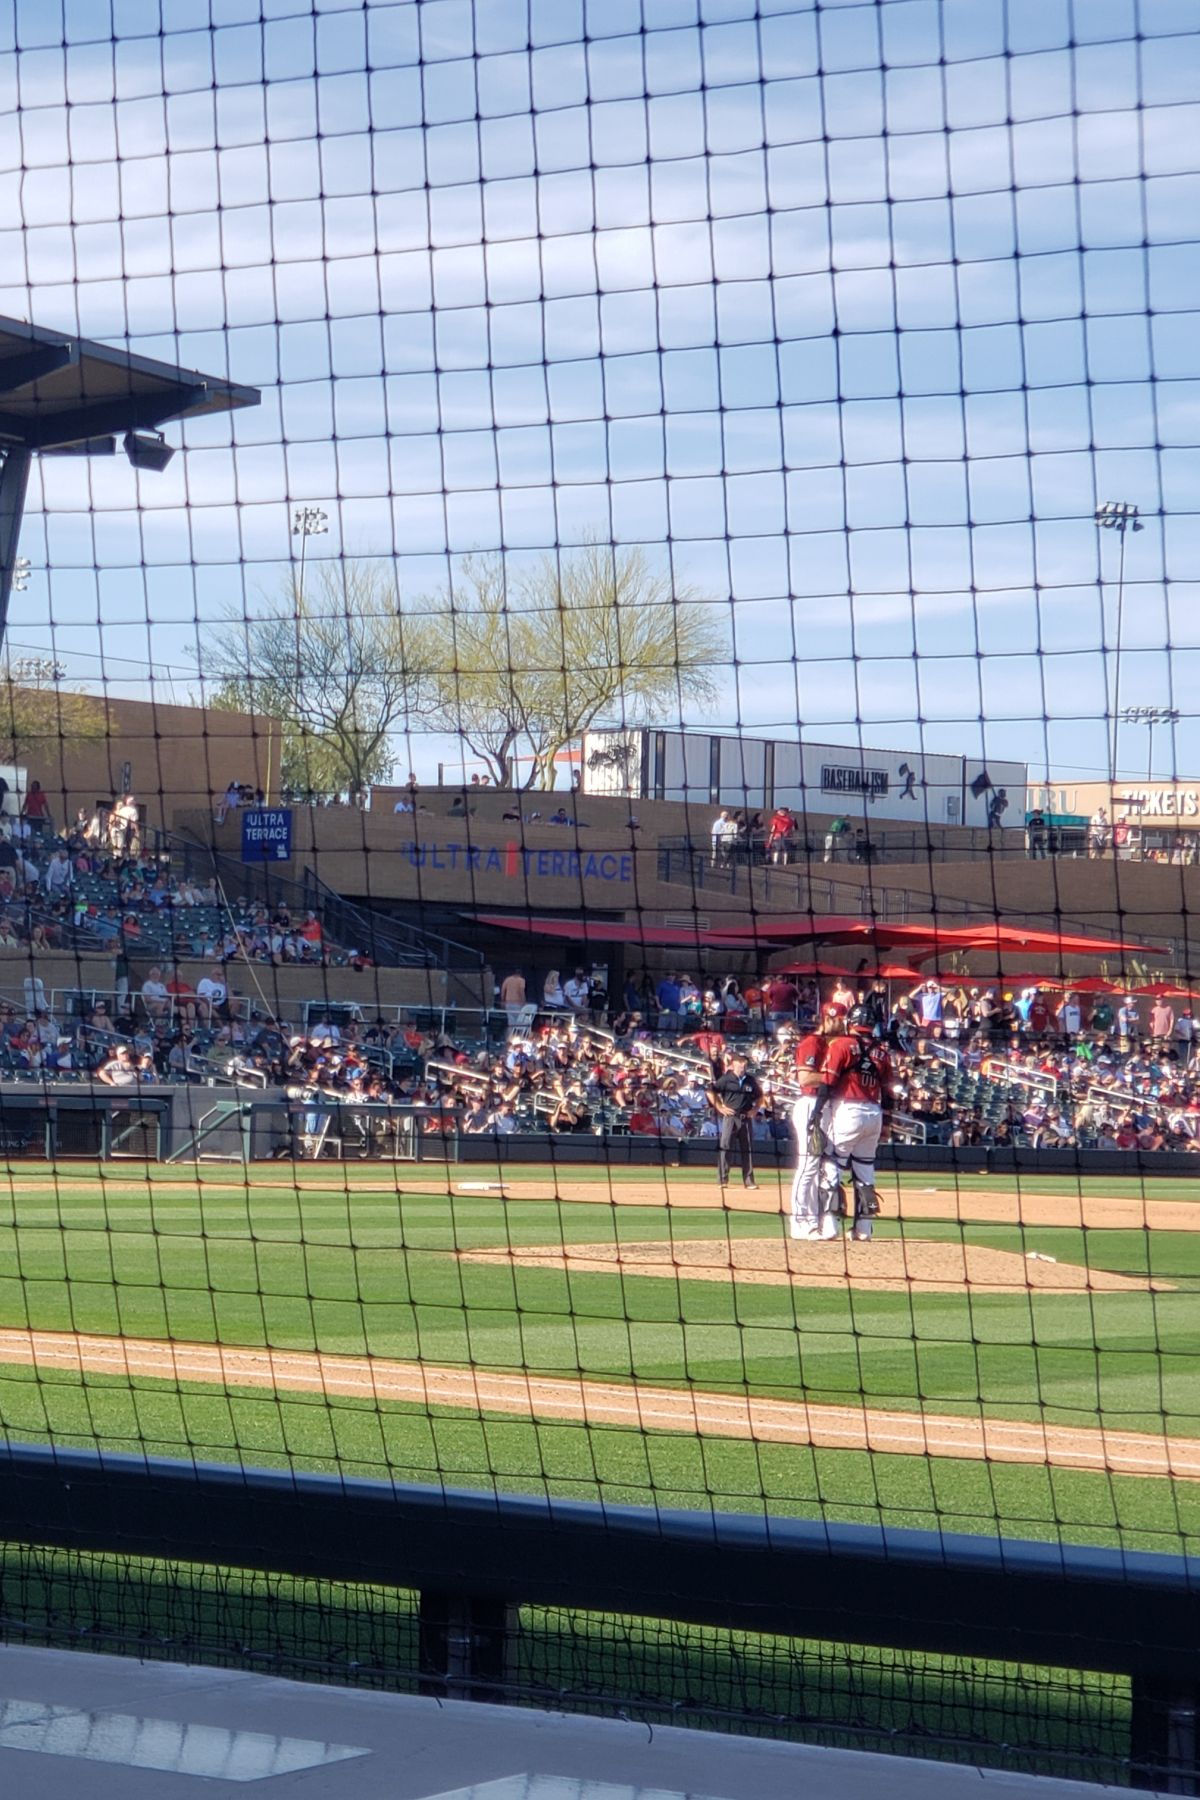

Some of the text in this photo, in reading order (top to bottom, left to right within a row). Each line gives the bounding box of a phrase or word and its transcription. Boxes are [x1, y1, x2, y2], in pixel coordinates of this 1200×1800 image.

[1121, 789, 1199, 816] TICKETS
[249, 812, 285, 826] ULTRA
[245, 826, 288, 841] TERRACE
[408, 841, 502, 874] ULTRA
[521, 847, 633, 883] TERRACE
